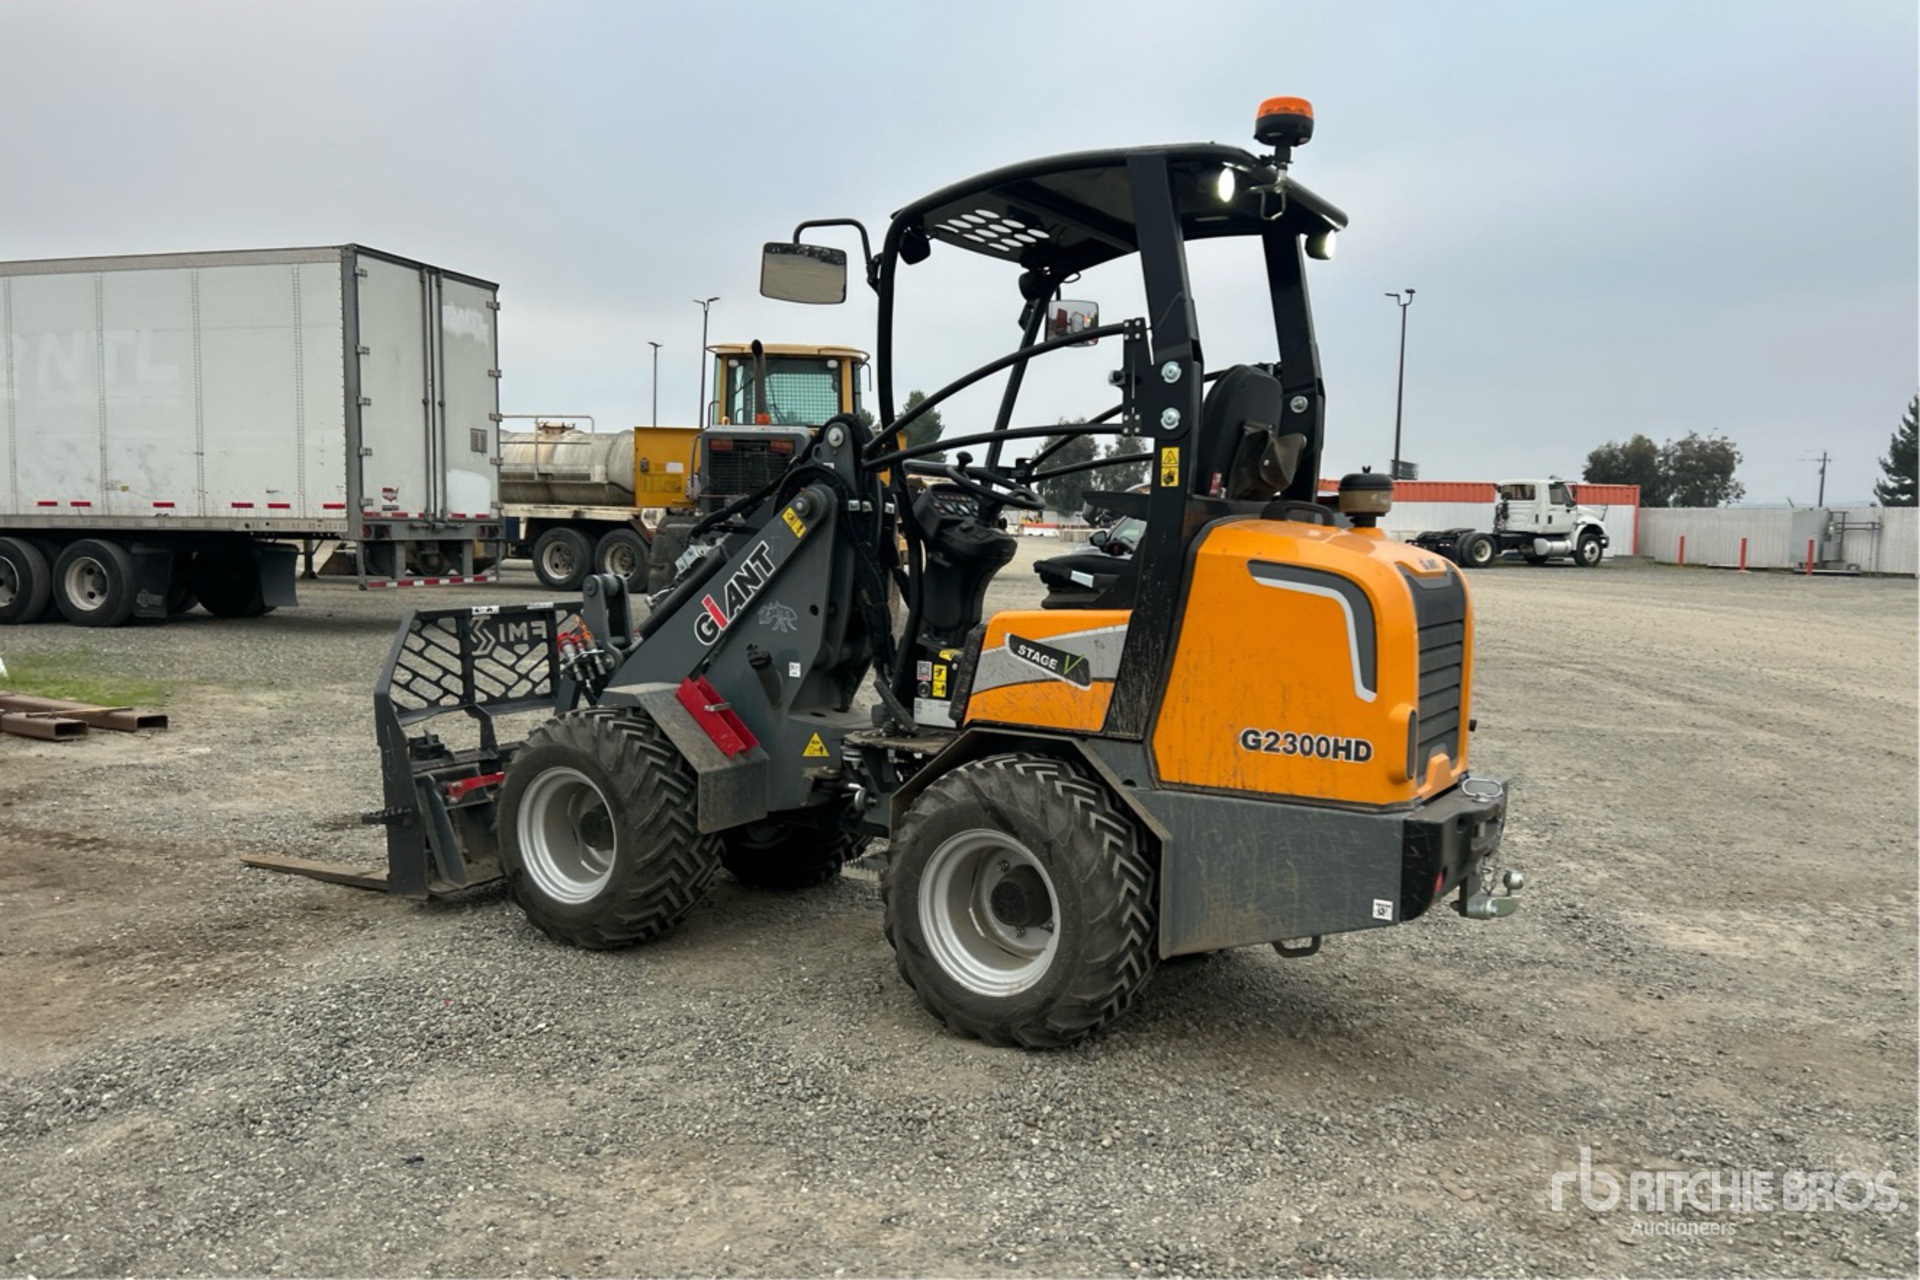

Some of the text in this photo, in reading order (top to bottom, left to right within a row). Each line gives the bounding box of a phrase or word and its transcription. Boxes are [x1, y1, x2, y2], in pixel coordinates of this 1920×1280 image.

[1017, 644, 1086, 675] STAGE V
[1239, 727, 1374, 765] G2300HD
